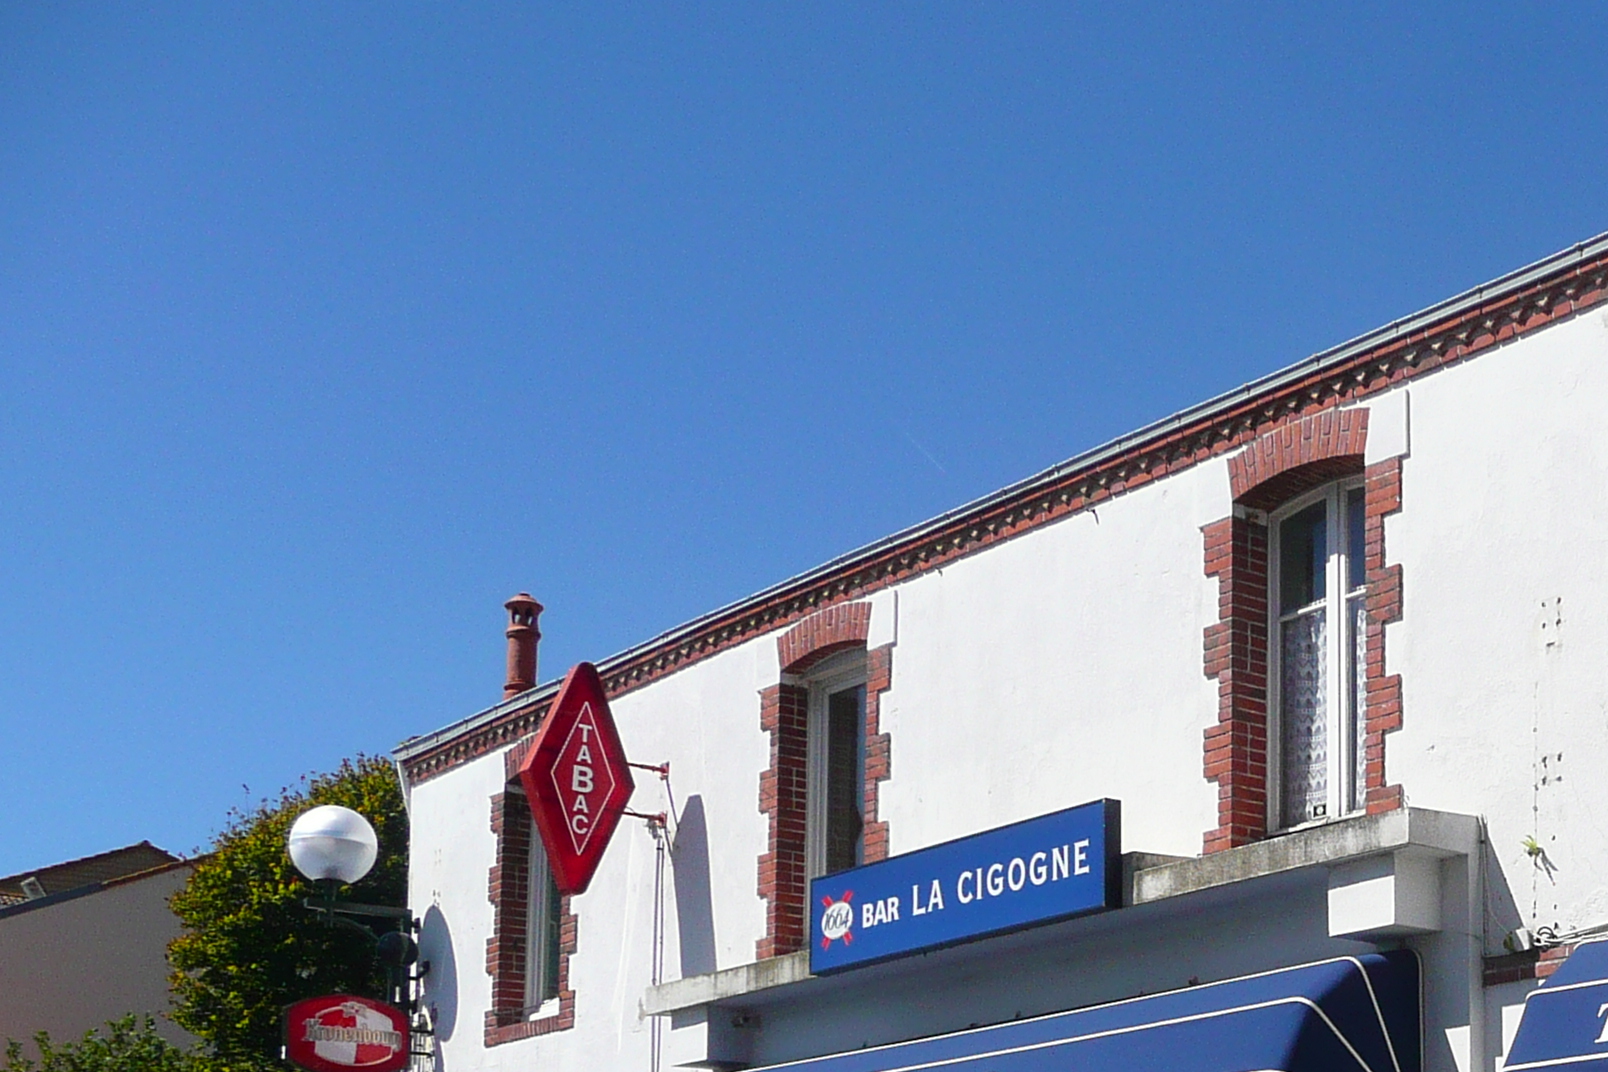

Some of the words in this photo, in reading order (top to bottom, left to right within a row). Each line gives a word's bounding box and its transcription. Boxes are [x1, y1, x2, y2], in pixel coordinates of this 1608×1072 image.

[571, 723, 594, 835] TABAC
[824, 907, 850, 931] 1664
[862, 896, 899, 928] BAR
[912, 879, 944, 916] LA
[957, 838, 1090, 904] CIGOGNE
